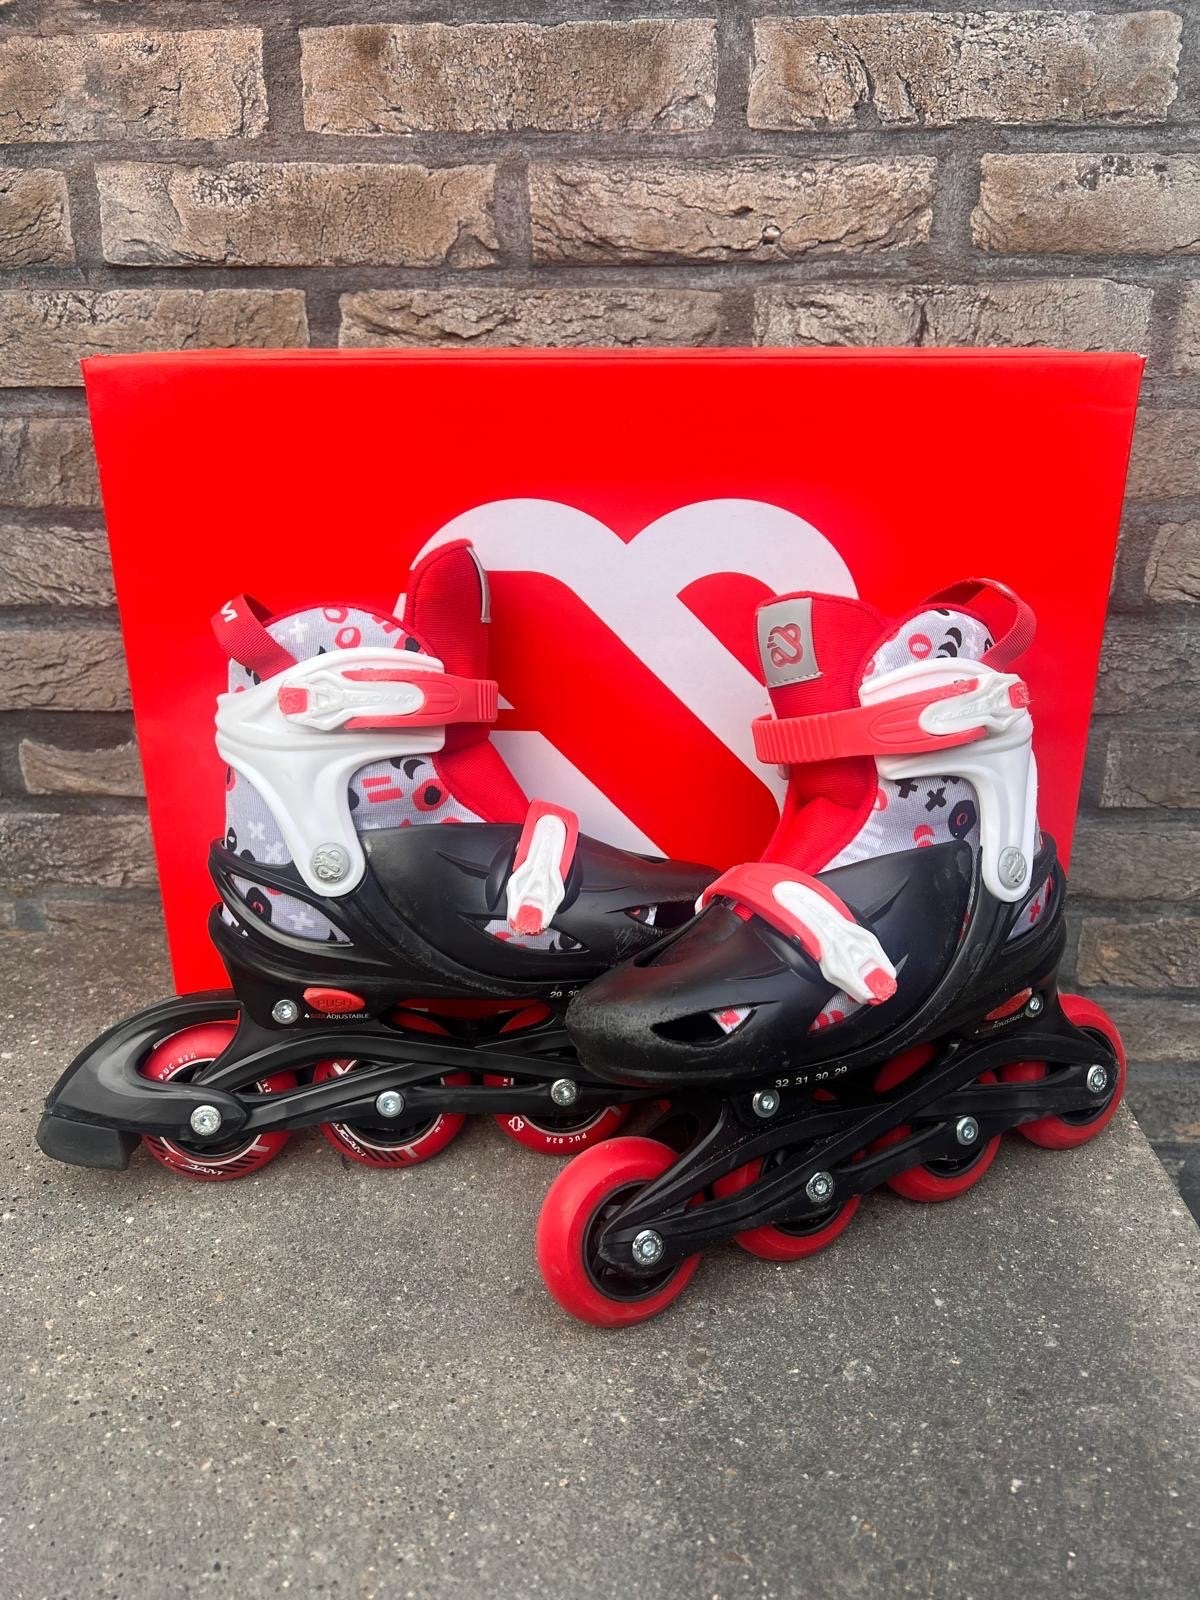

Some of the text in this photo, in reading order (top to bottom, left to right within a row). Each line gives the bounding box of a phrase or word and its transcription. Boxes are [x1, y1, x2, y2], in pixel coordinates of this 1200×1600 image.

[326, 1012, 369, 1020] ADJUSTABLE
[775, 1065, 848, 1088] 32 31 30 29
[546, 1132, 587, 1144] PUC 82A
